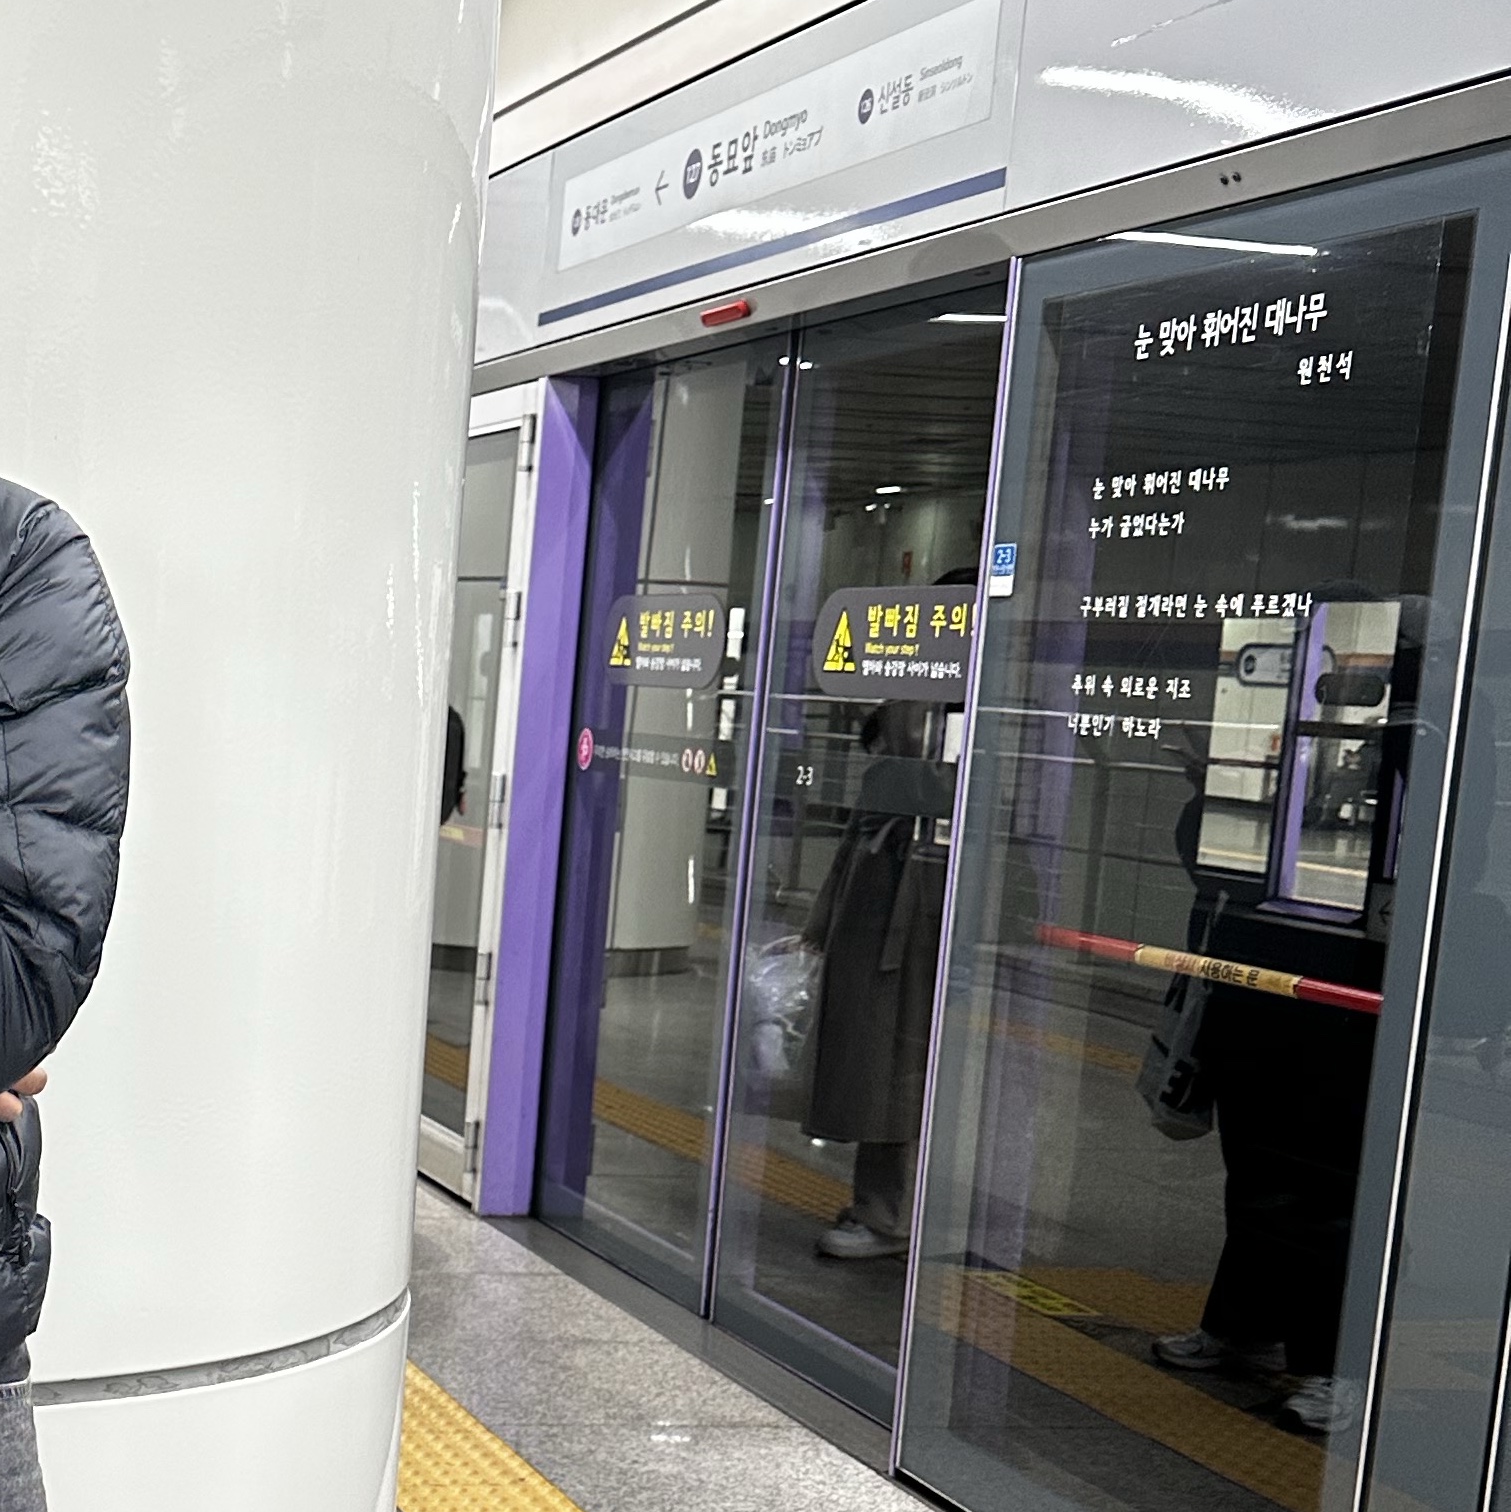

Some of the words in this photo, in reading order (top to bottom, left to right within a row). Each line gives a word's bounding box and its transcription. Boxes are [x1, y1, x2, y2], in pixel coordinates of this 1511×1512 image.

[763, 109, 808, 139] Dongmyo
[707, 125, 759, 188] 동묘앞
[1134, 323, 1154, 361] 눈
[1159, 313, 1198, 357] 맞아
[1201, 302, 1260, 348] 휘어진
[1265, 292, 1328, 337] 대나무
[1092, 477, 1106, 500] 눈
[1111, 474, 1138, 499] 맞아
[1188, 466, 1230, 492] 대나무
[1088, 515, 1114, 540] 누가
[1193, 593, 1208, 618] 눈
[1214, 592, 1245, 618] 속에
[639, 609, 676, 639] 발빠짐
[680, 608, 715, 639] 주의!
[867, 603, 919, 639] 발빠짐
[1101, 674, 1115, 698] 속
[1119, 675, 1159, 700] 외로운
[1165, 676, 1192, 700] 지조
[1121, 715, 1162, 740] 하노라
[795, 765, 814, 787] 2-3
